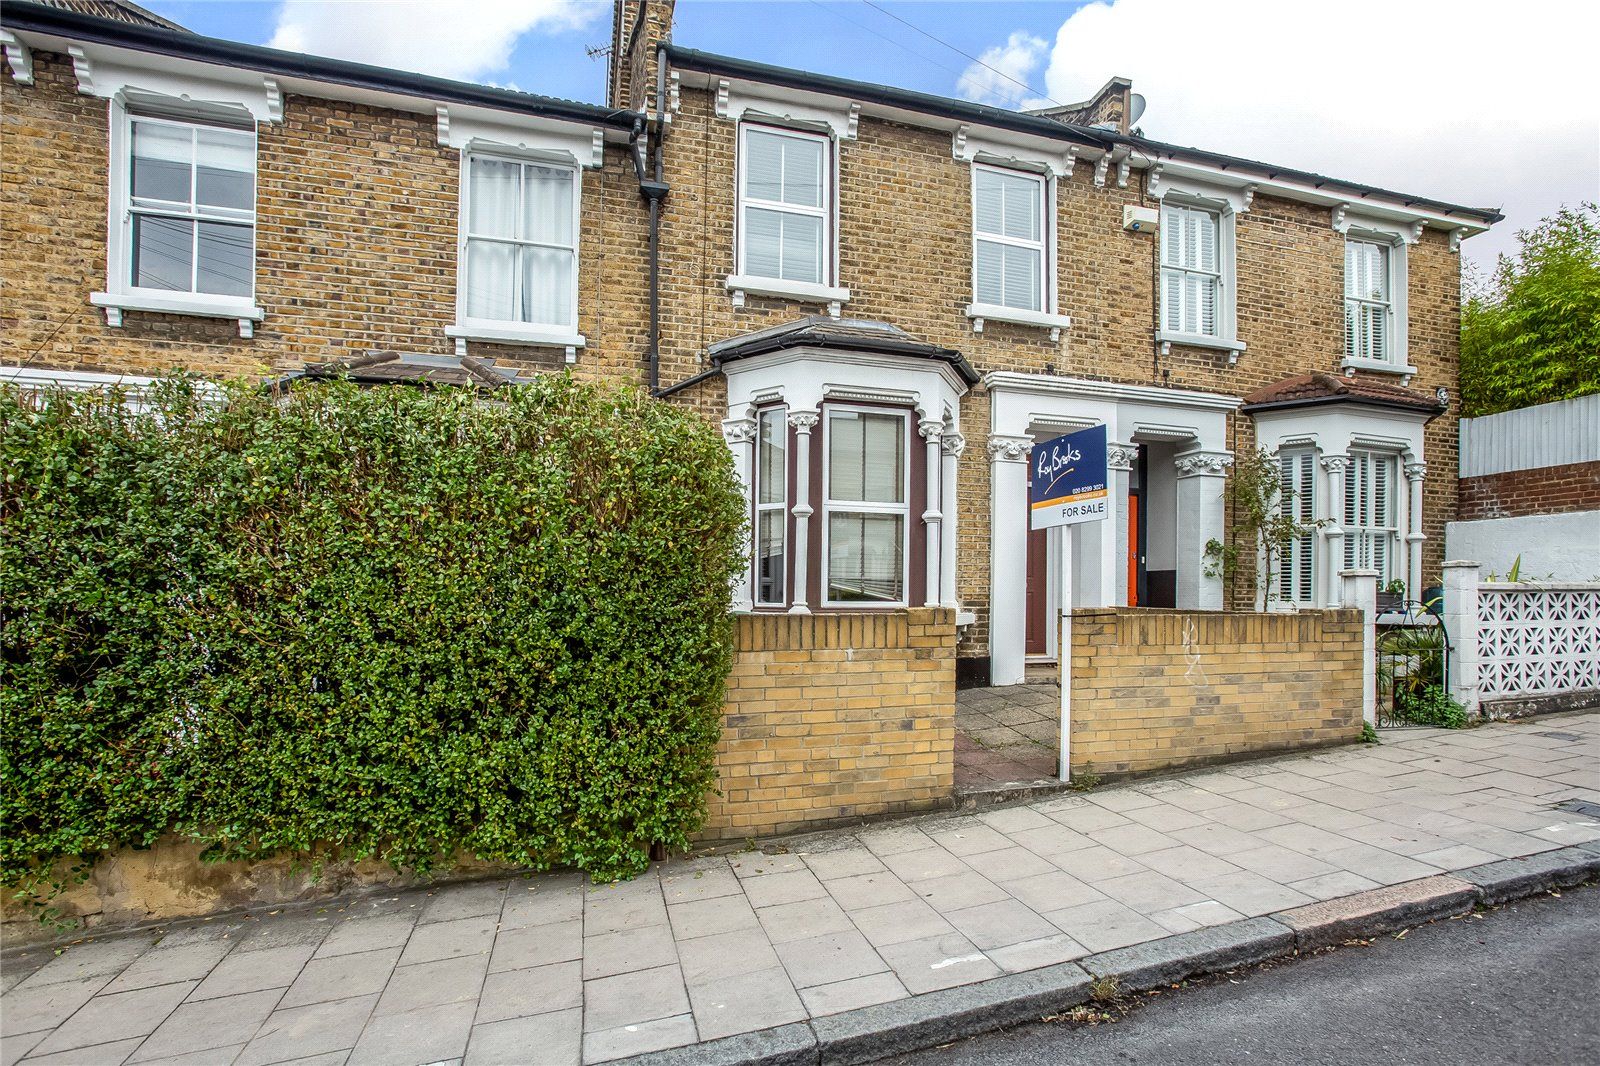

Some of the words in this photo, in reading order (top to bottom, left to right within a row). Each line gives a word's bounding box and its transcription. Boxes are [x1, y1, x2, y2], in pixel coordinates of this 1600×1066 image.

[1038, 451, 1053, 482] Roy
[1062, 507, 1079, 518] FOR
[1080, 502, 1104, 515] SALE
